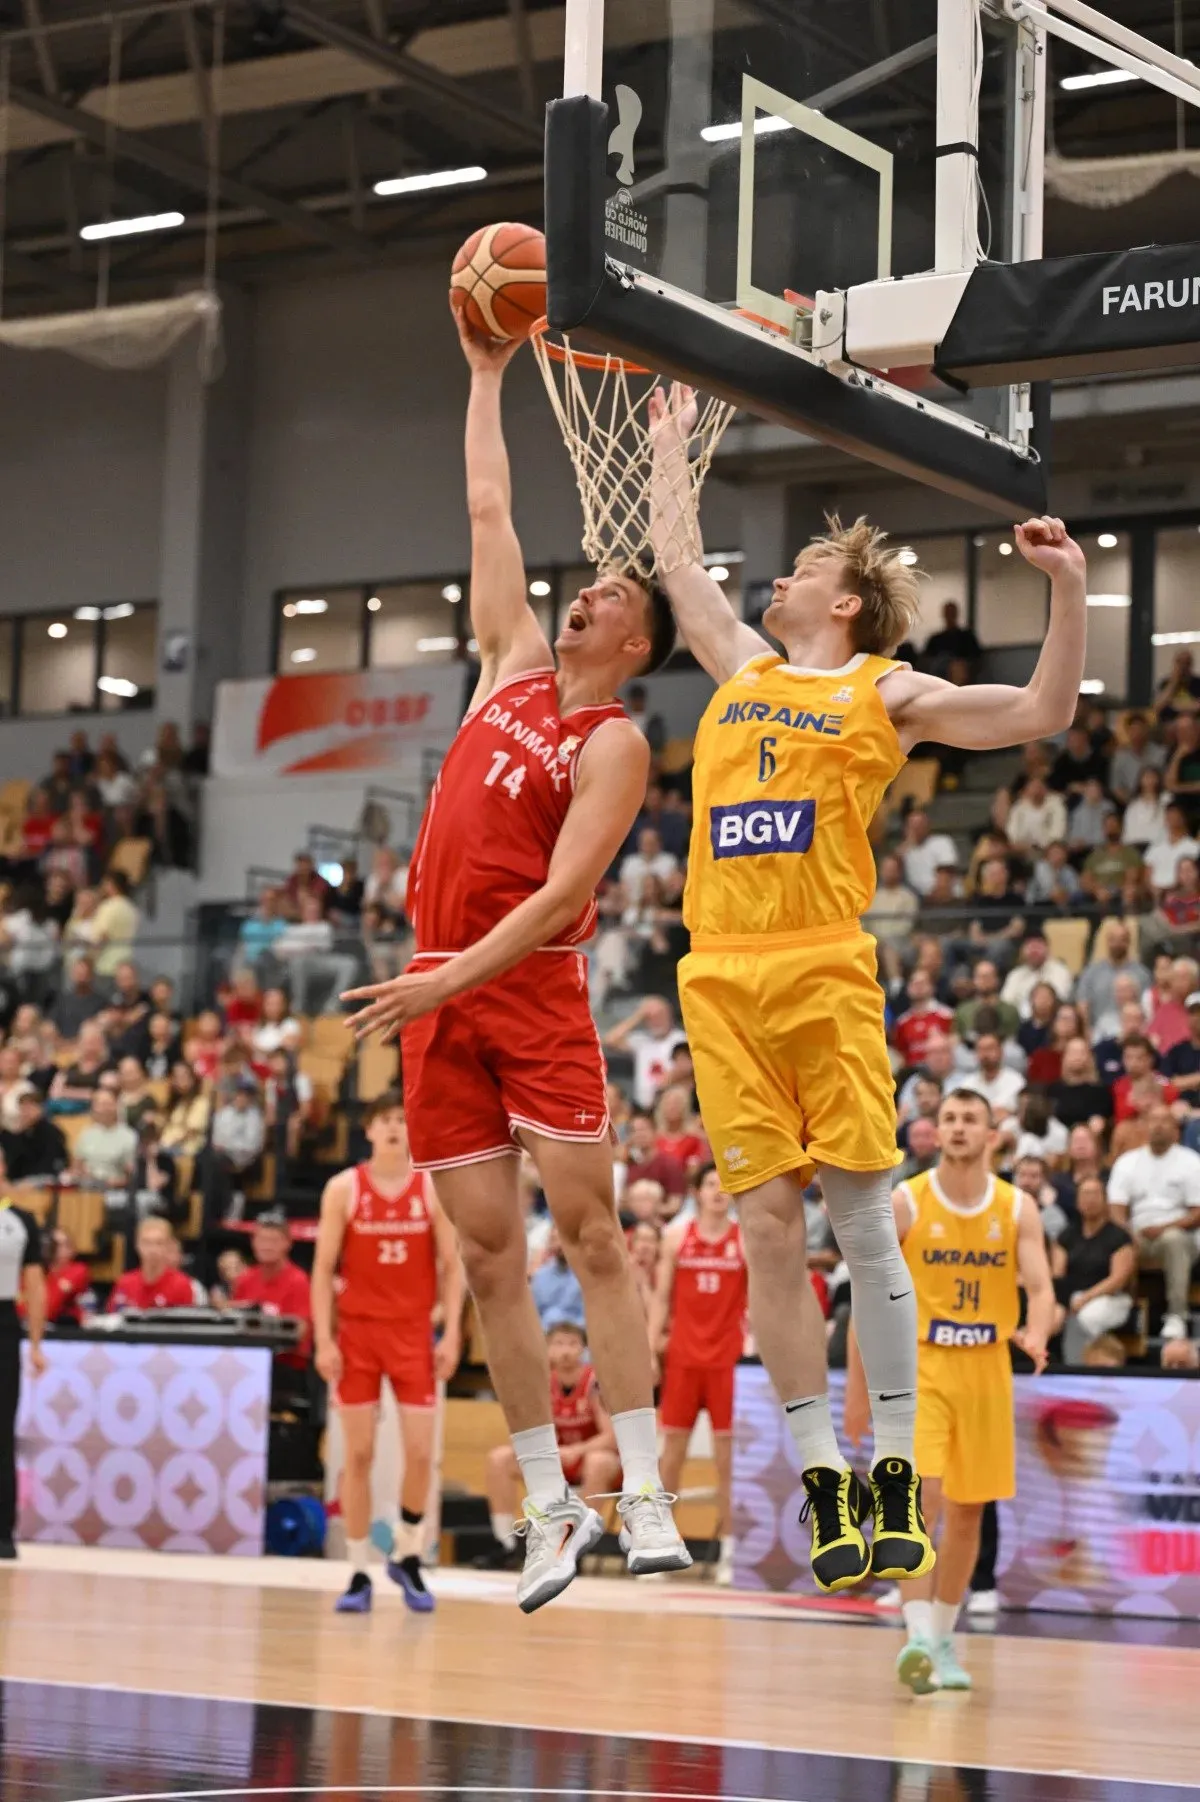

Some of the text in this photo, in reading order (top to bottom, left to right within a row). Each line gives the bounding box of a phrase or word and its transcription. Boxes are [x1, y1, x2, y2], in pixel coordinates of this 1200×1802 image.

[482, 703, 568, 793] DANMARK
[757, 737, 777, 783] 6
[483, 750, 527, 800] 14
[718, 810, 802, 848] BGV
[952, 1277, 980, 1312] 34
[933, 1324, 992, 1347] BGV
